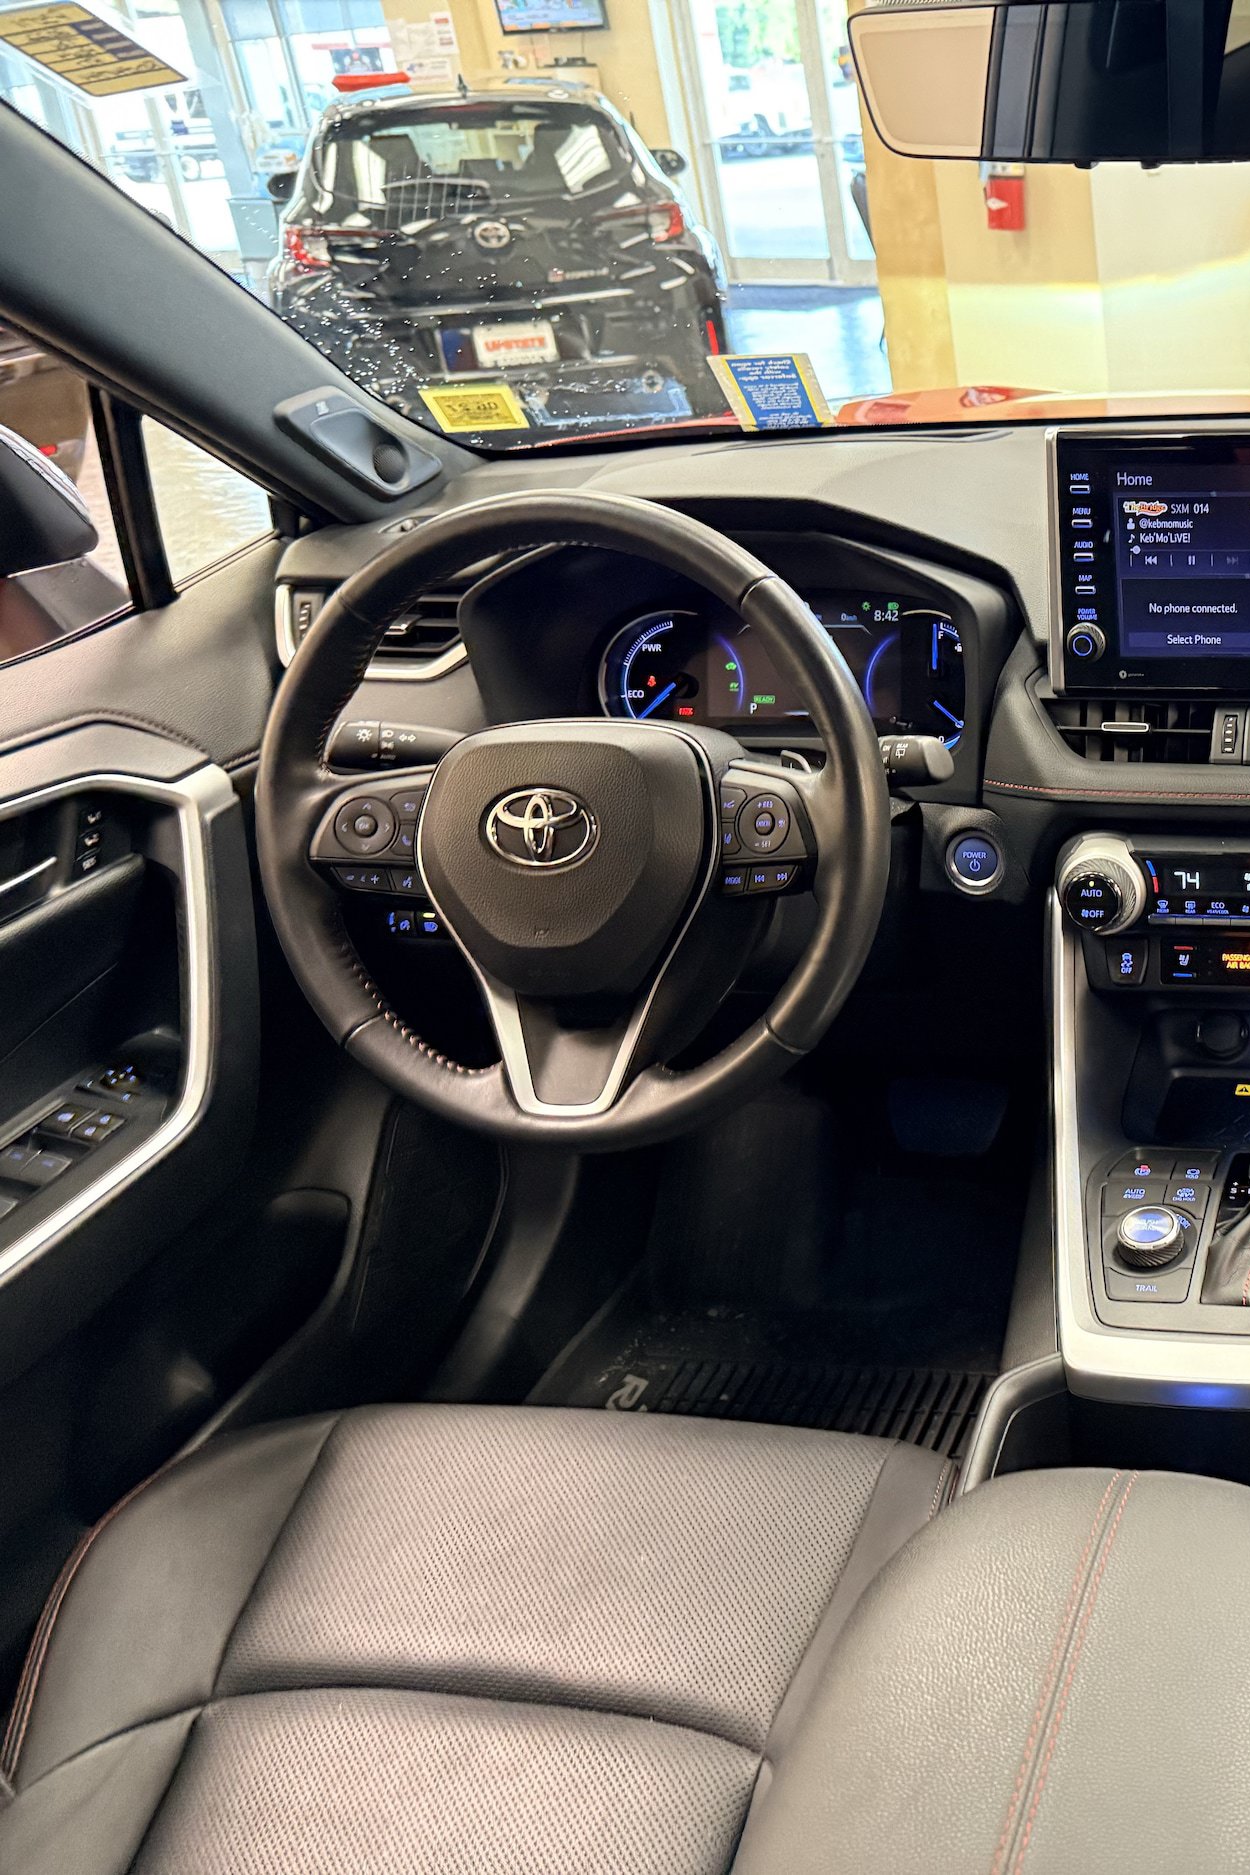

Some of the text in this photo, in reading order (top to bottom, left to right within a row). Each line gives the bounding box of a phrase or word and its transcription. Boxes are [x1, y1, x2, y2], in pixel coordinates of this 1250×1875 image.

[1070, 473, 1089, 481] HOME
[1117, 472, 1153, 486] Home
[1072, 507, 1091, 515] MENU
[1171, 504, 1190, 514] SXM
[1193, 503, 1209, 514] 014
[1139, 519, 1193, 530] @kebmomusic
[1149, 603, 1238, 614] No phone connected.
[874, 610, 899, 622] 8:42
[938, 632, 944, 640] F
[1167, 635, 1222, 645] Select Phone
[641, 644, 662, 652] PWR
[627, 690, 645, 698] ECO
[750, 703, 757, 714] P
[962, 851, 986, 859] POWER
[1174, 871, 1200, 890] 74
[1081, 889, 1103, 897] AUTO
[1090, 909, 1104, 918] OFF
[1120, 966, 1133, 974] OFF
[1136, 1284, 1157, 1292] TRAIL
